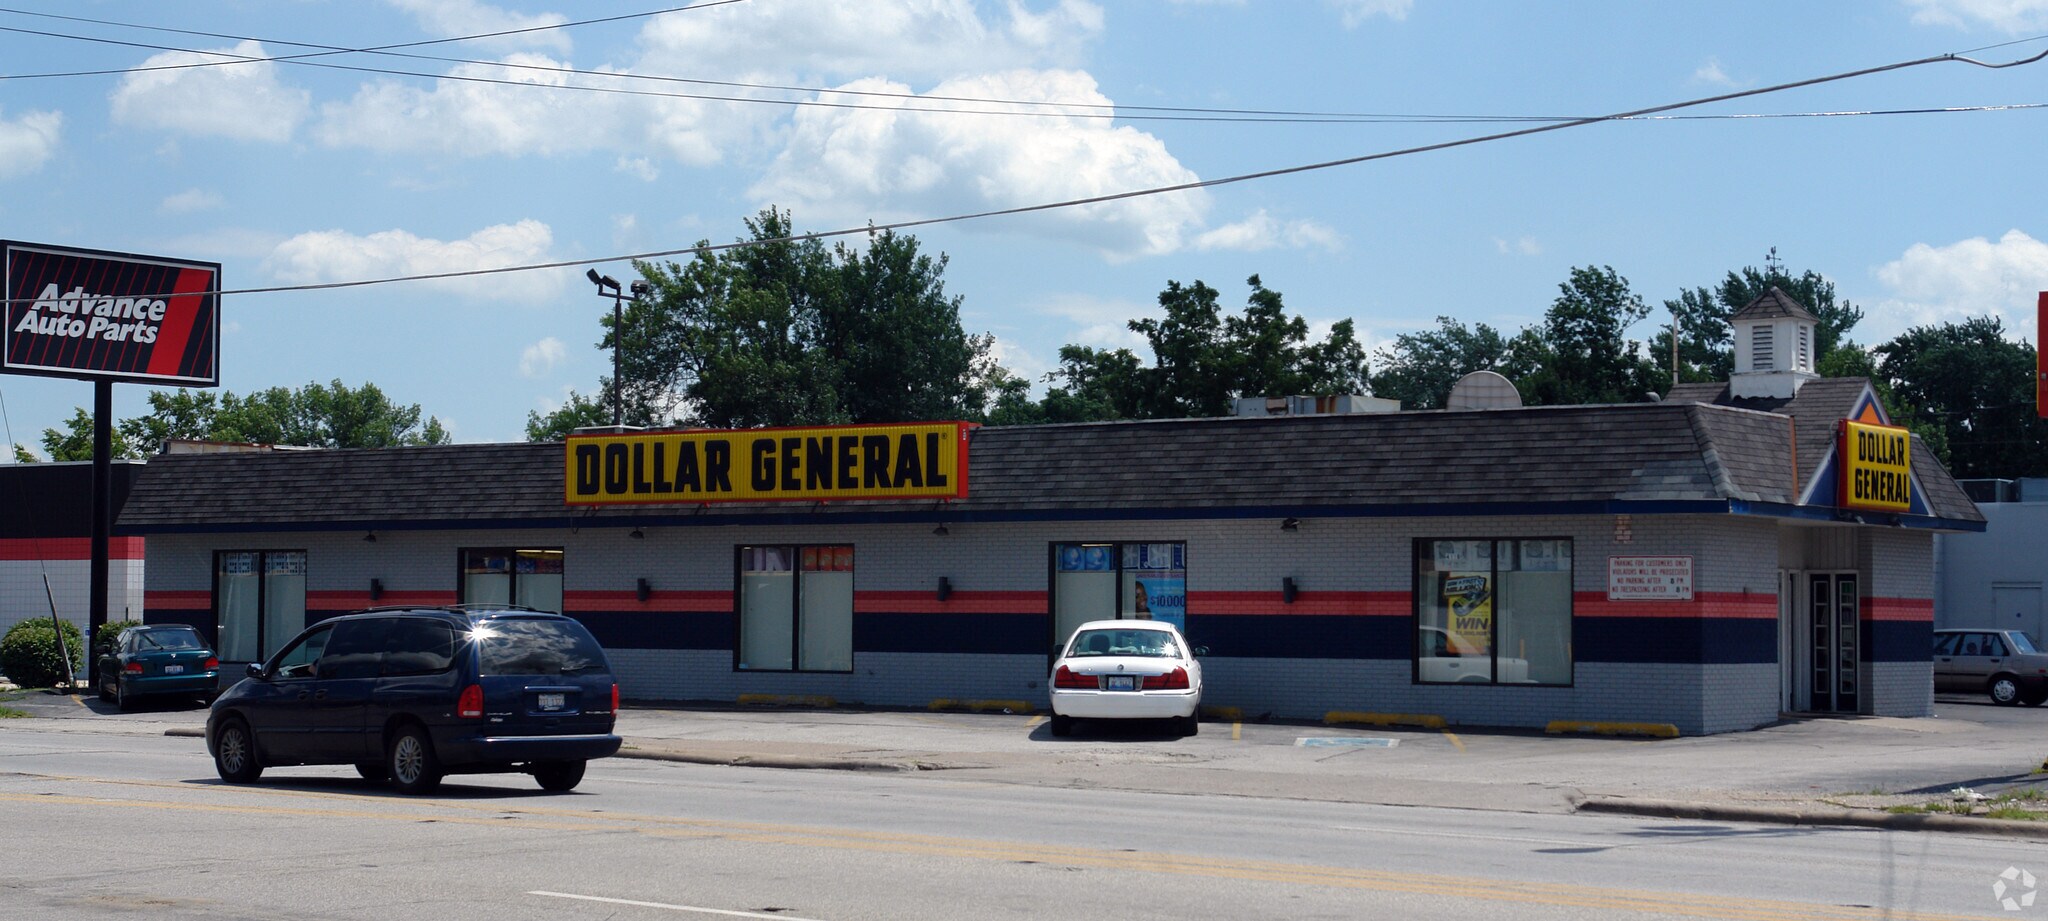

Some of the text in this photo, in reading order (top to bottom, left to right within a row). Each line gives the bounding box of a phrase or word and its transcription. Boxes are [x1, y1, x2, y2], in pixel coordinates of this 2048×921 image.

[31, 283, 167, 322] Advance
[14, 310, 159, 344] Auto Parts
[576, 432, 948, 495] DOLLAR GENERAL
[1858, 430, 1905, 467] DOLLAR
[1855, 468, 1909, 504] GENERAL
[1456, 617, 1488, 630] WIN
